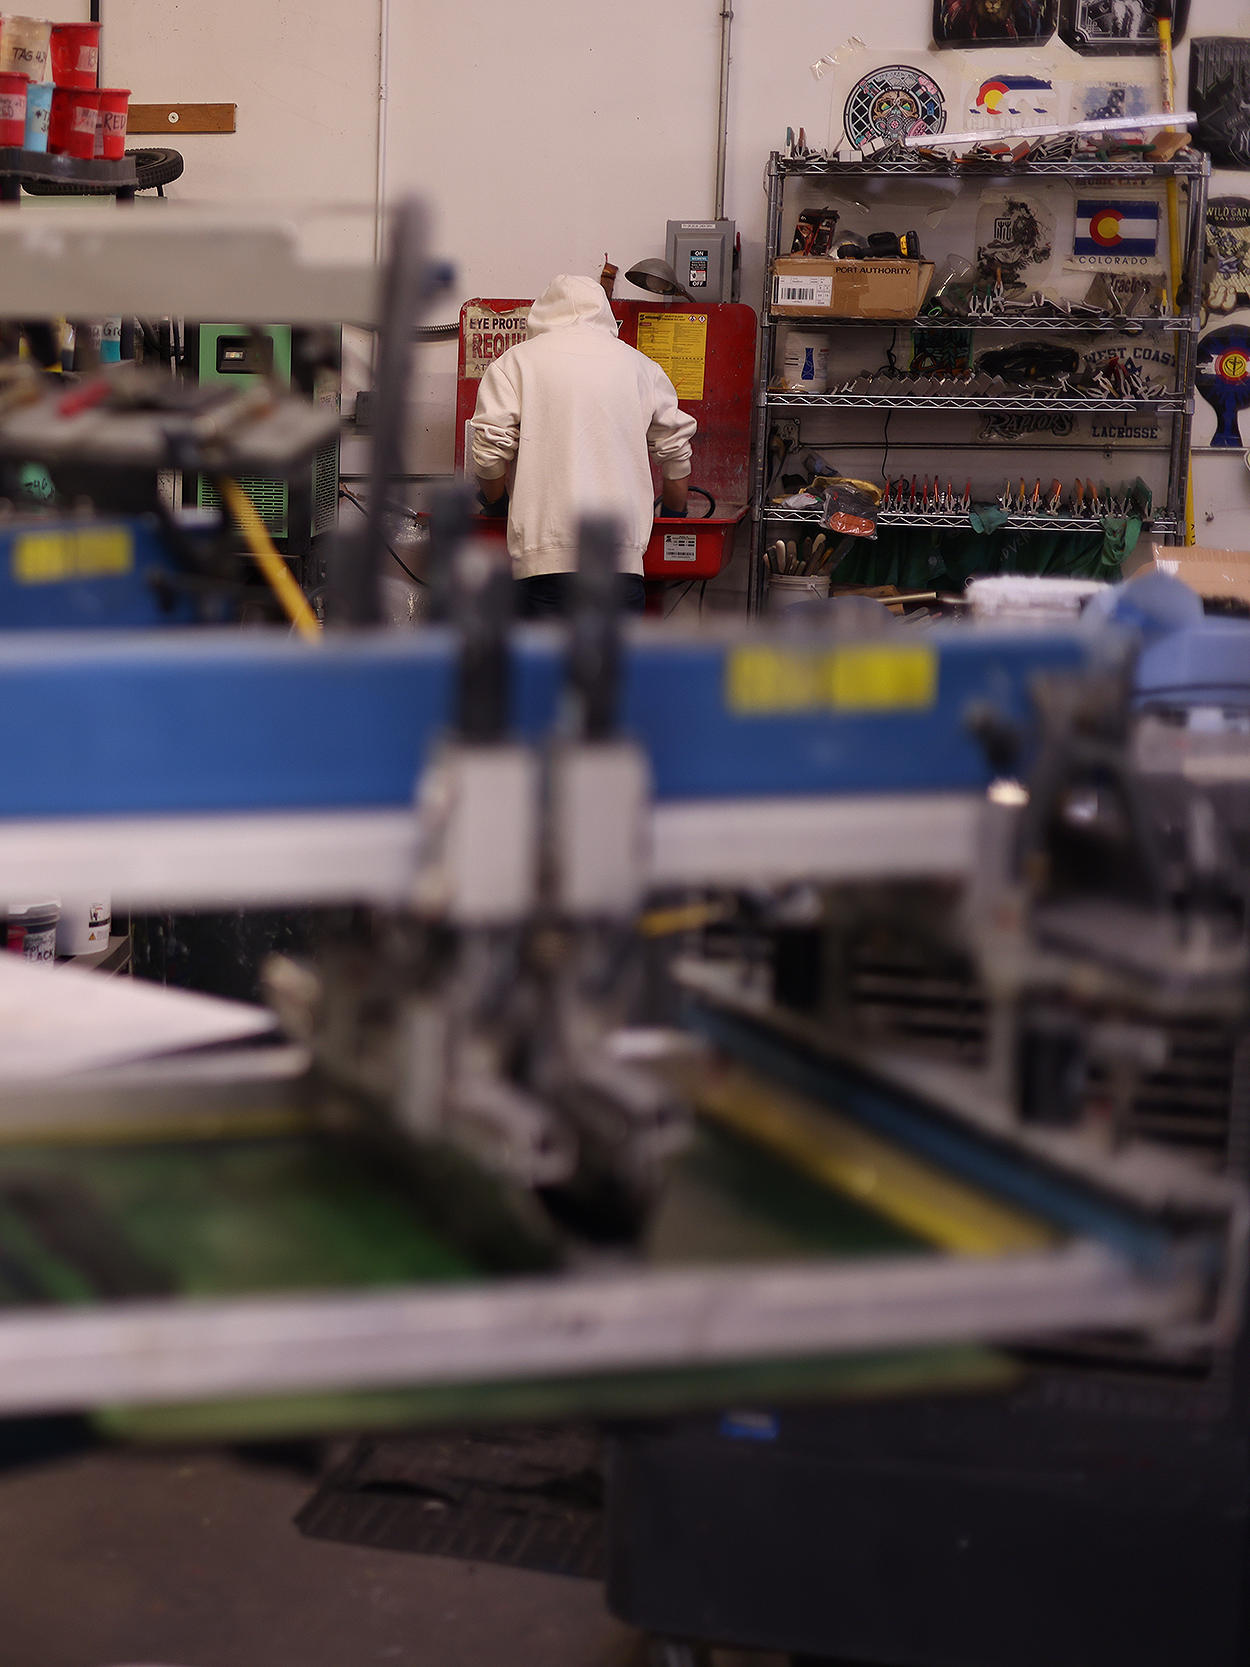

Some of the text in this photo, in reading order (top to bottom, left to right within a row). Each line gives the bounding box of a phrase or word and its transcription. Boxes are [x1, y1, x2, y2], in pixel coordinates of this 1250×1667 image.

[12, 47, 33, 61] TAG
[104, 112, 126, 131] RED
[1078, 256, 1148, 265] COLORADO
[469, 318, 526, 329] EYE PROTE
[1085, 347, 1127, 365] WEST
[979, 411, 1073, 440] RAPTORS
[1092, 426, 1158, 439] LACROSSE
[1000, 531, 1032, 562] DVEN
